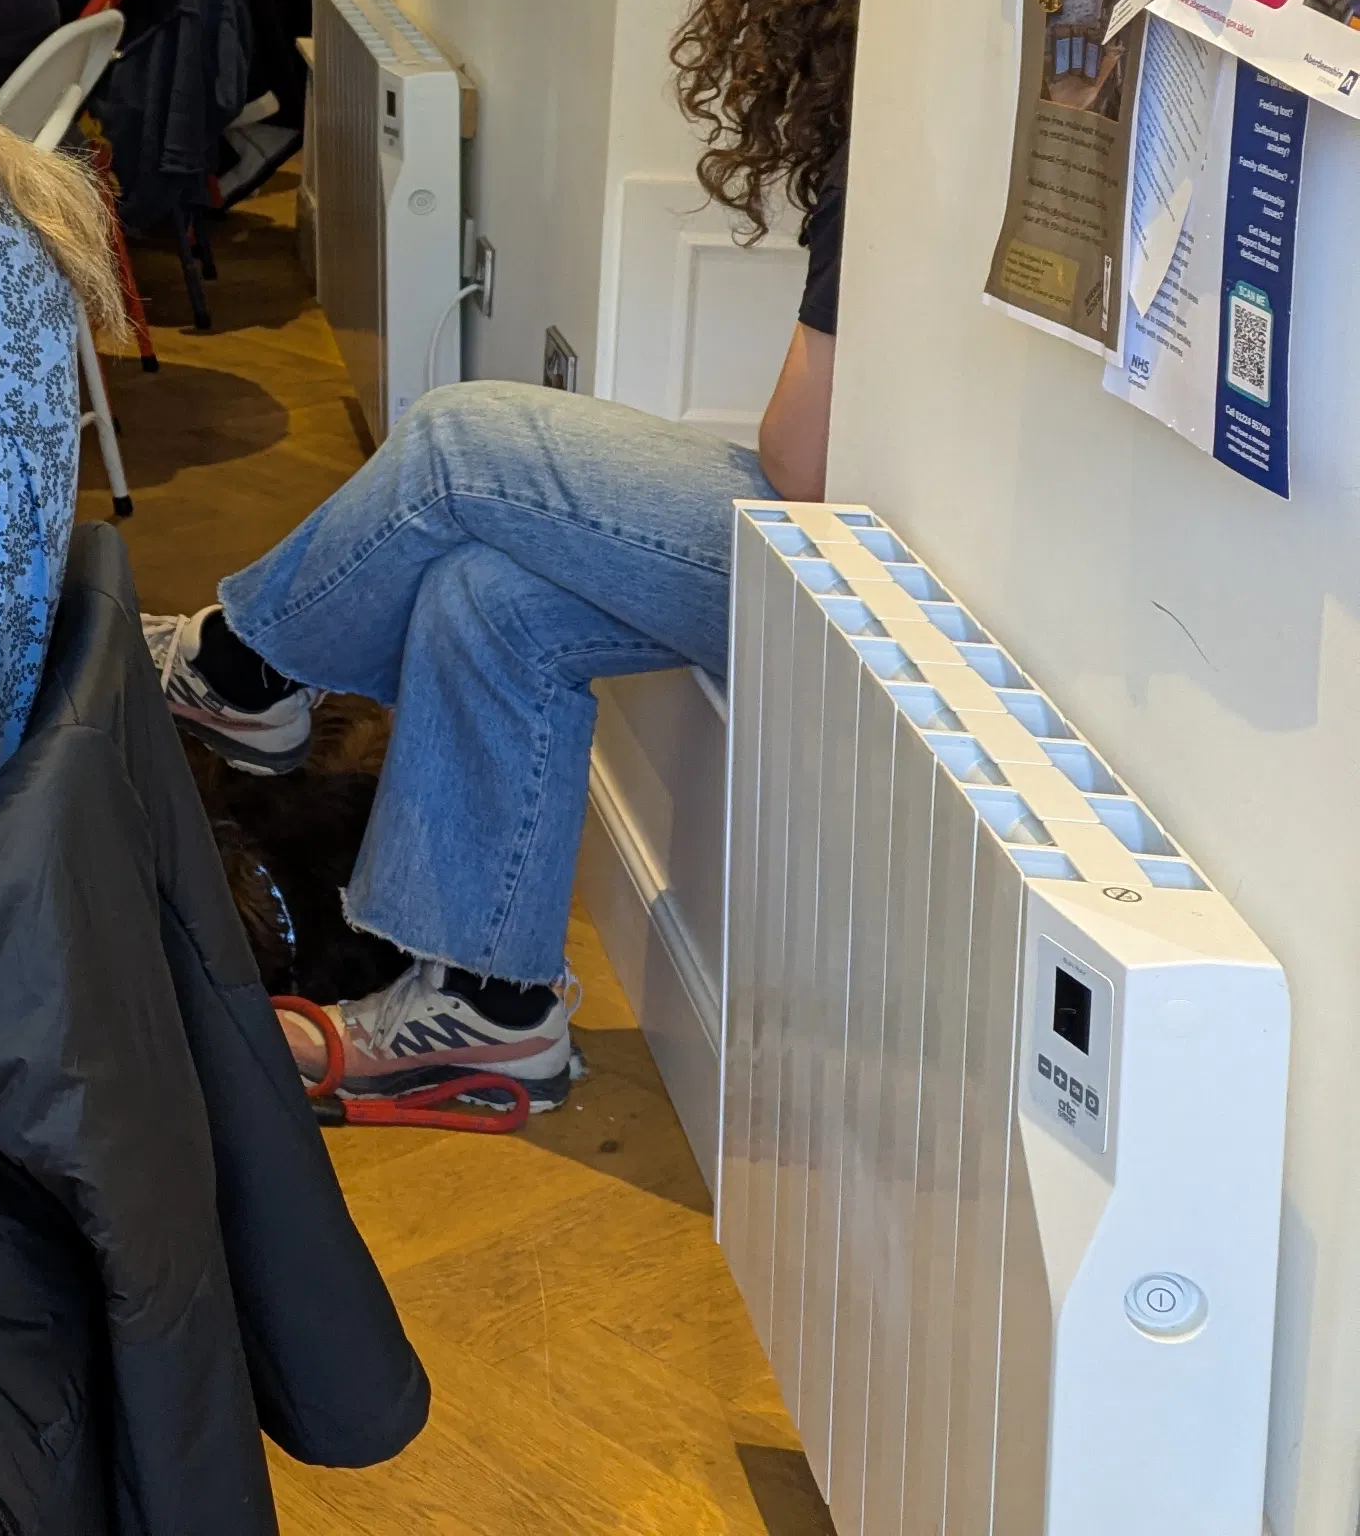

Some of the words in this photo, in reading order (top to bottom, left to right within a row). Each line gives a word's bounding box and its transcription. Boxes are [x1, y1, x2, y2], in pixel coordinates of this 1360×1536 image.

[1303, 52, 1344, 79] Aberdeenshire
[1259, 98, 1279, 116] Feeling
[1279, 105, 1294, 118] lost?
[1253, 122, 1279, 142] Suffering
[1279, 132, 1292, 144] with
[1266, 142, 1291, 158] anxiety?
[1239, 155, 1258, 173] Family
[1257, 162, 1288, 182] difficulties?
[1252, 186, 1286, 209] Relationship
[1262, 204, 1285, 220] issues?
[1248, 224, 1260, 236] Get
[1259, 228, 1271, 243] help
[1271, 235, 1282, 246] and
[1237, 234, 1258, 250] support
[1257, 241, 1271, 255] from
[1270, 249, 1281, 260] our
[1240, 248, 1266, 267] dedicated
[1265, 259, 1280, 273] team
[1238, 285, 1256, 302] SCAN
[1255, 293, 1267, 307] ME
[1135, 321, 1147, 337] Help
[1131, 353, 1150, 375] NHS
[1225, 404, 1236, 418] Call
[1058, 1097, 1077, 1119] atc
